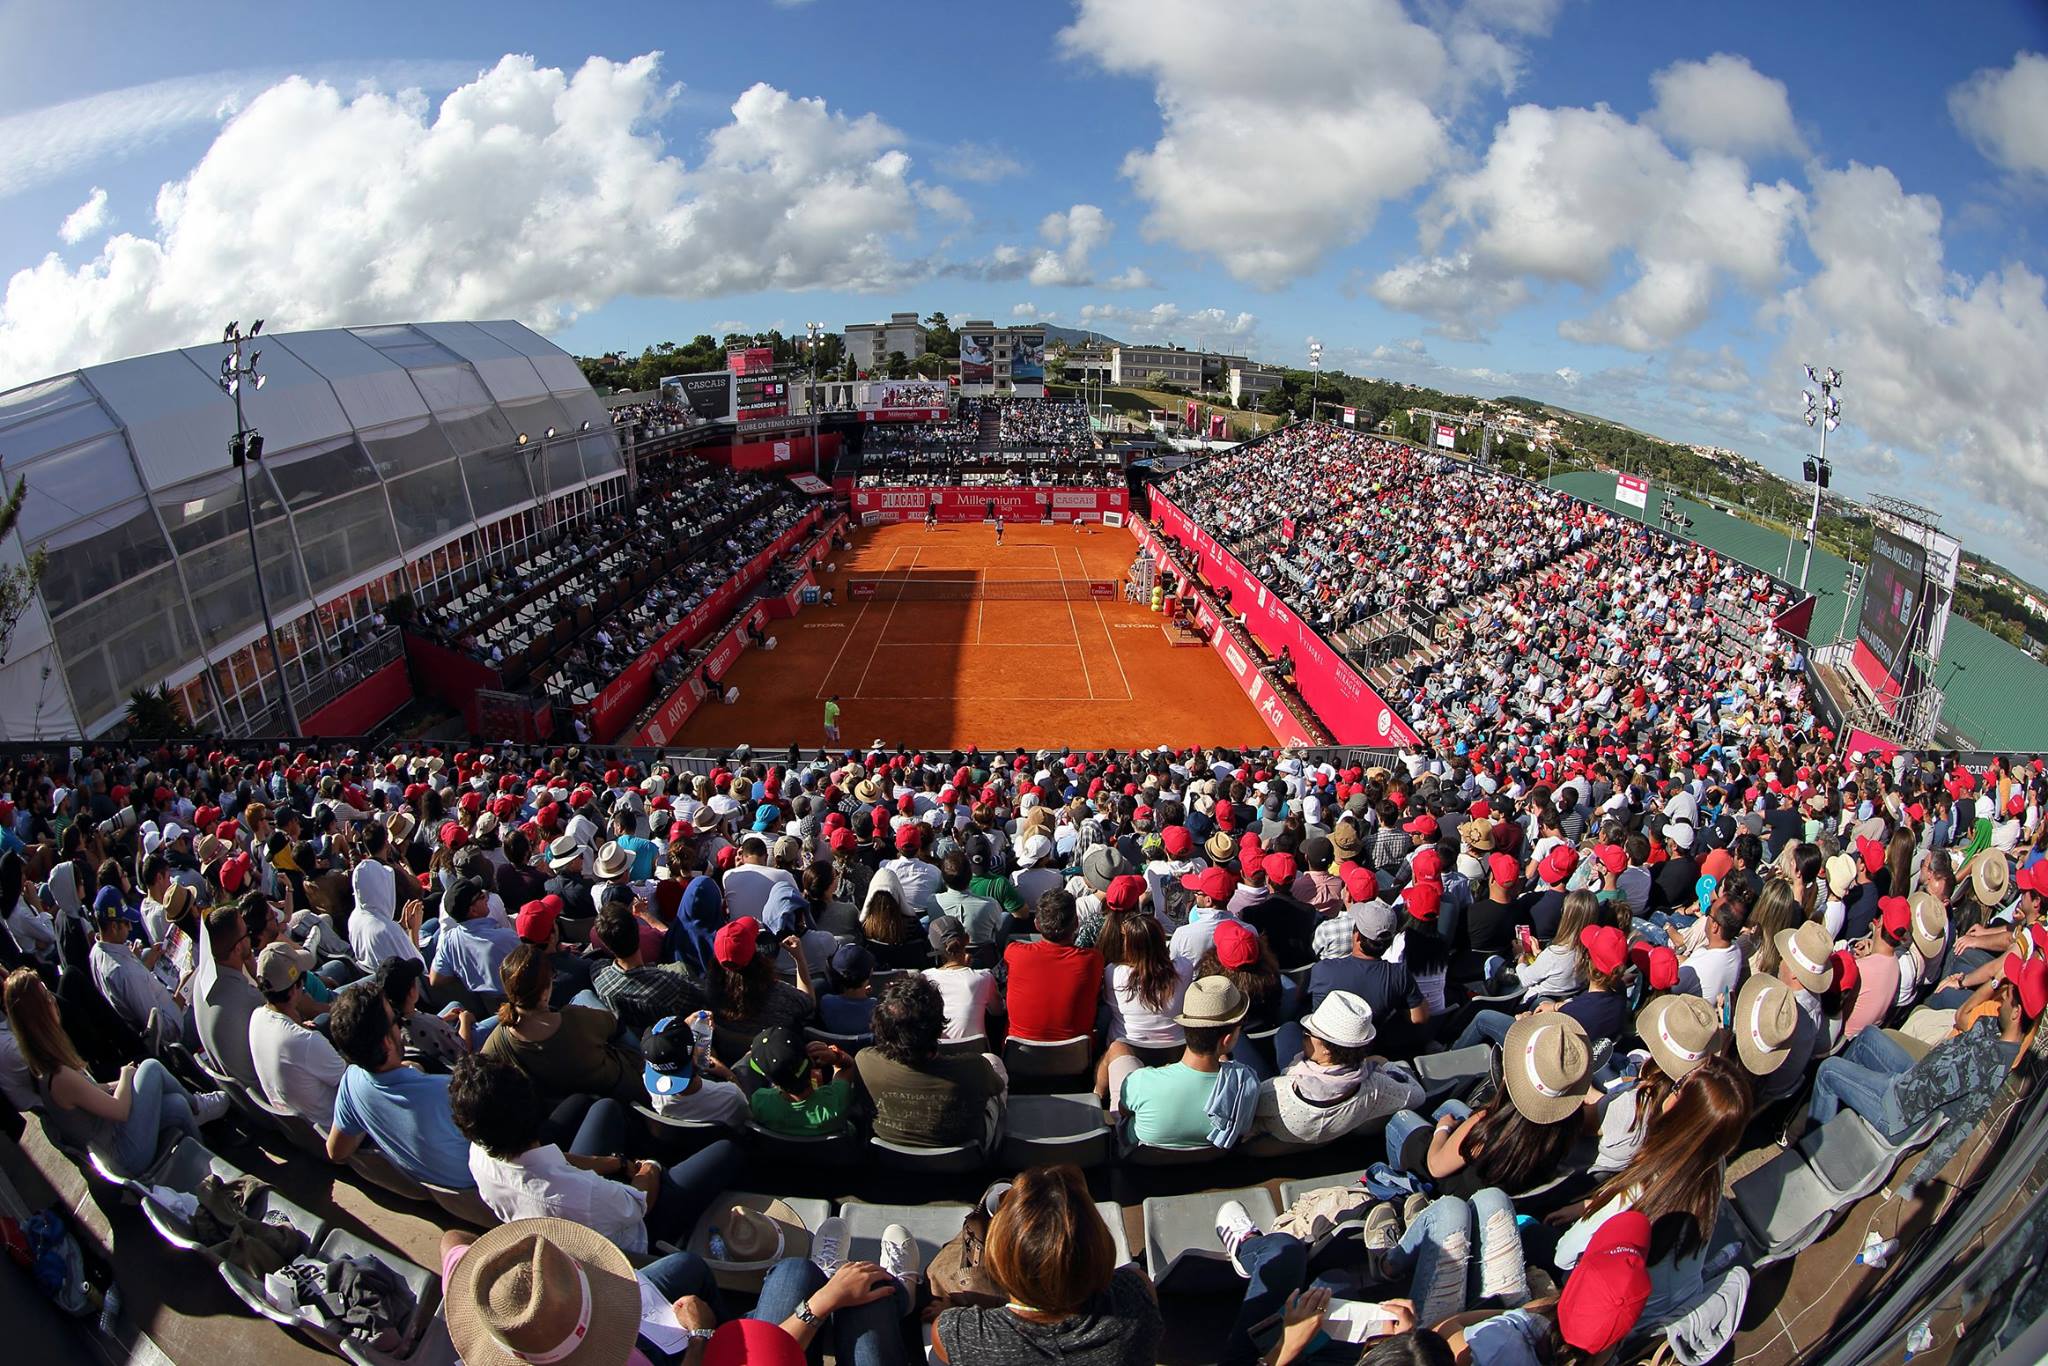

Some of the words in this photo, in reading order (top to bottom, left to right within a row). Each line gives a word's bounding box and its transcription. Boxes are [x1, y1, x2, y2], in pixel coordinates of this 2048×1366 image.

[687, 378, 727, 390] CASCAIS
[737, 423, 757, 432] CLUBE
[768, 420, 785, 429] TENIS
[786, 418, 796, 426] DO
[882, 493, 925, 507] PLACARD
[1056, 495, 1094, 504] CASCAIS
[668, 696, 687, 727] AVIS
